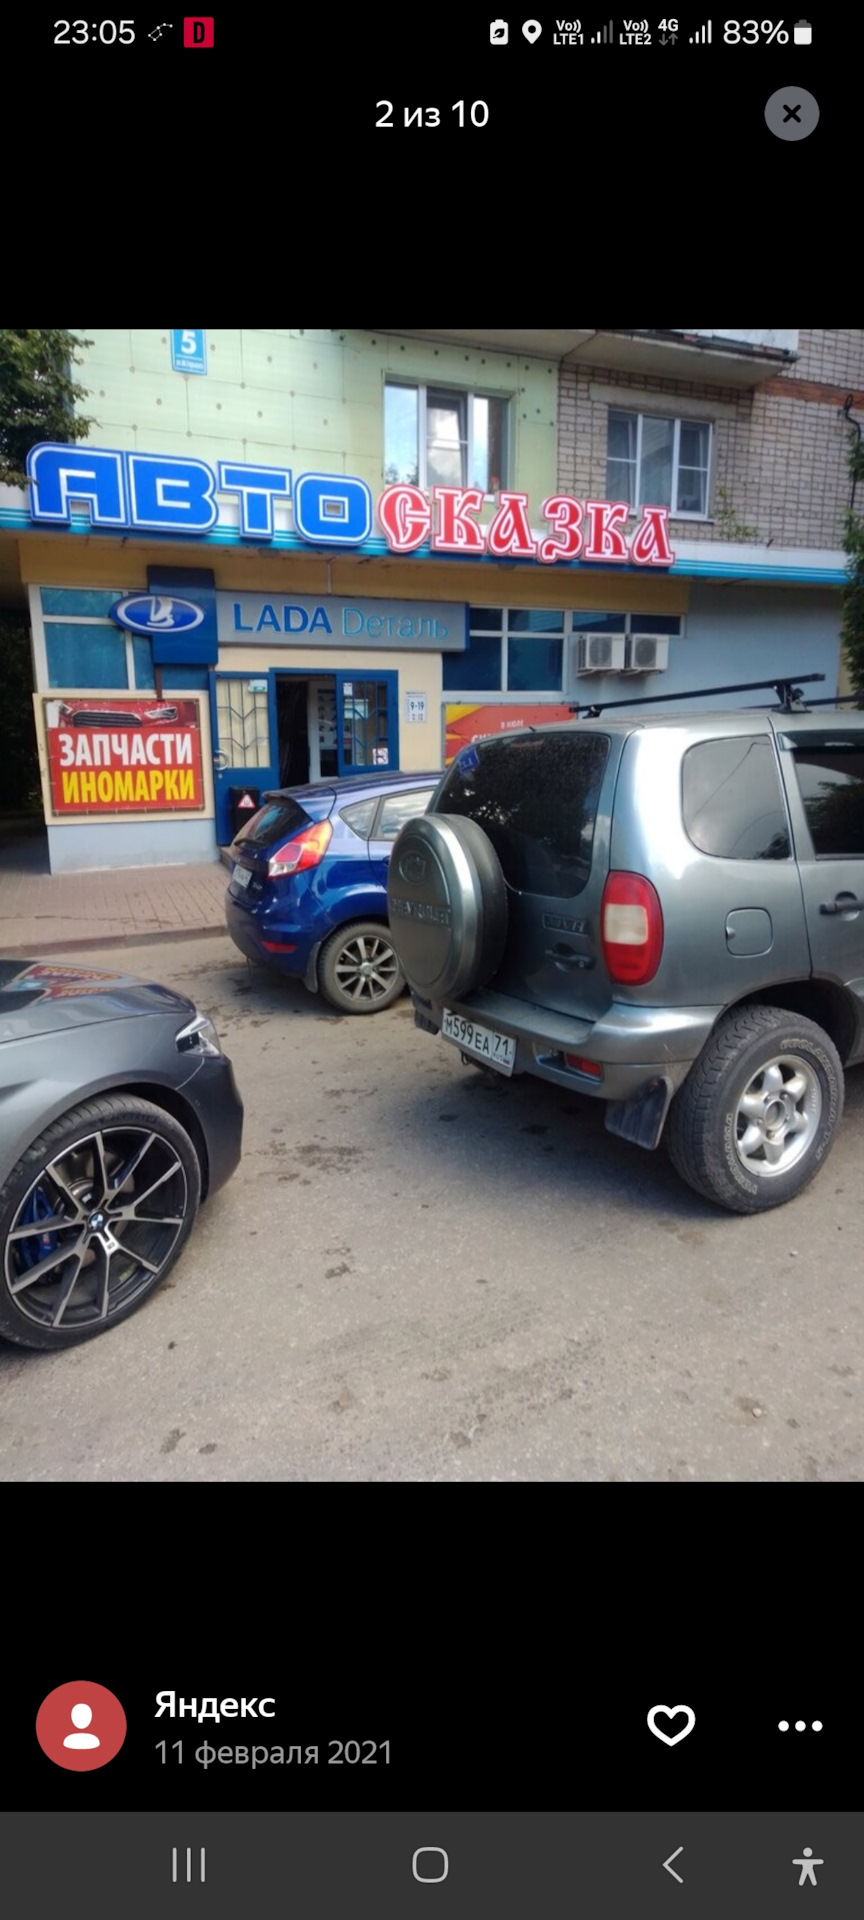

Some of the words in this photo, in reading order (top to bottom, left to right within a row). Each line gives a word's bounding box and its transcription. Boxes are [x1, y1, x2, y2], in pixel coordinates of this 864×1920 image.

[181, 329, 197, 355] 5
[233, 603, 333, 634] LADA
[58, 732, 193, 768] ЗАПЧАСТИ
[62, 768, 195, 804] ИНОМАРКИ
[494, 1034, 510, 1057] 71
